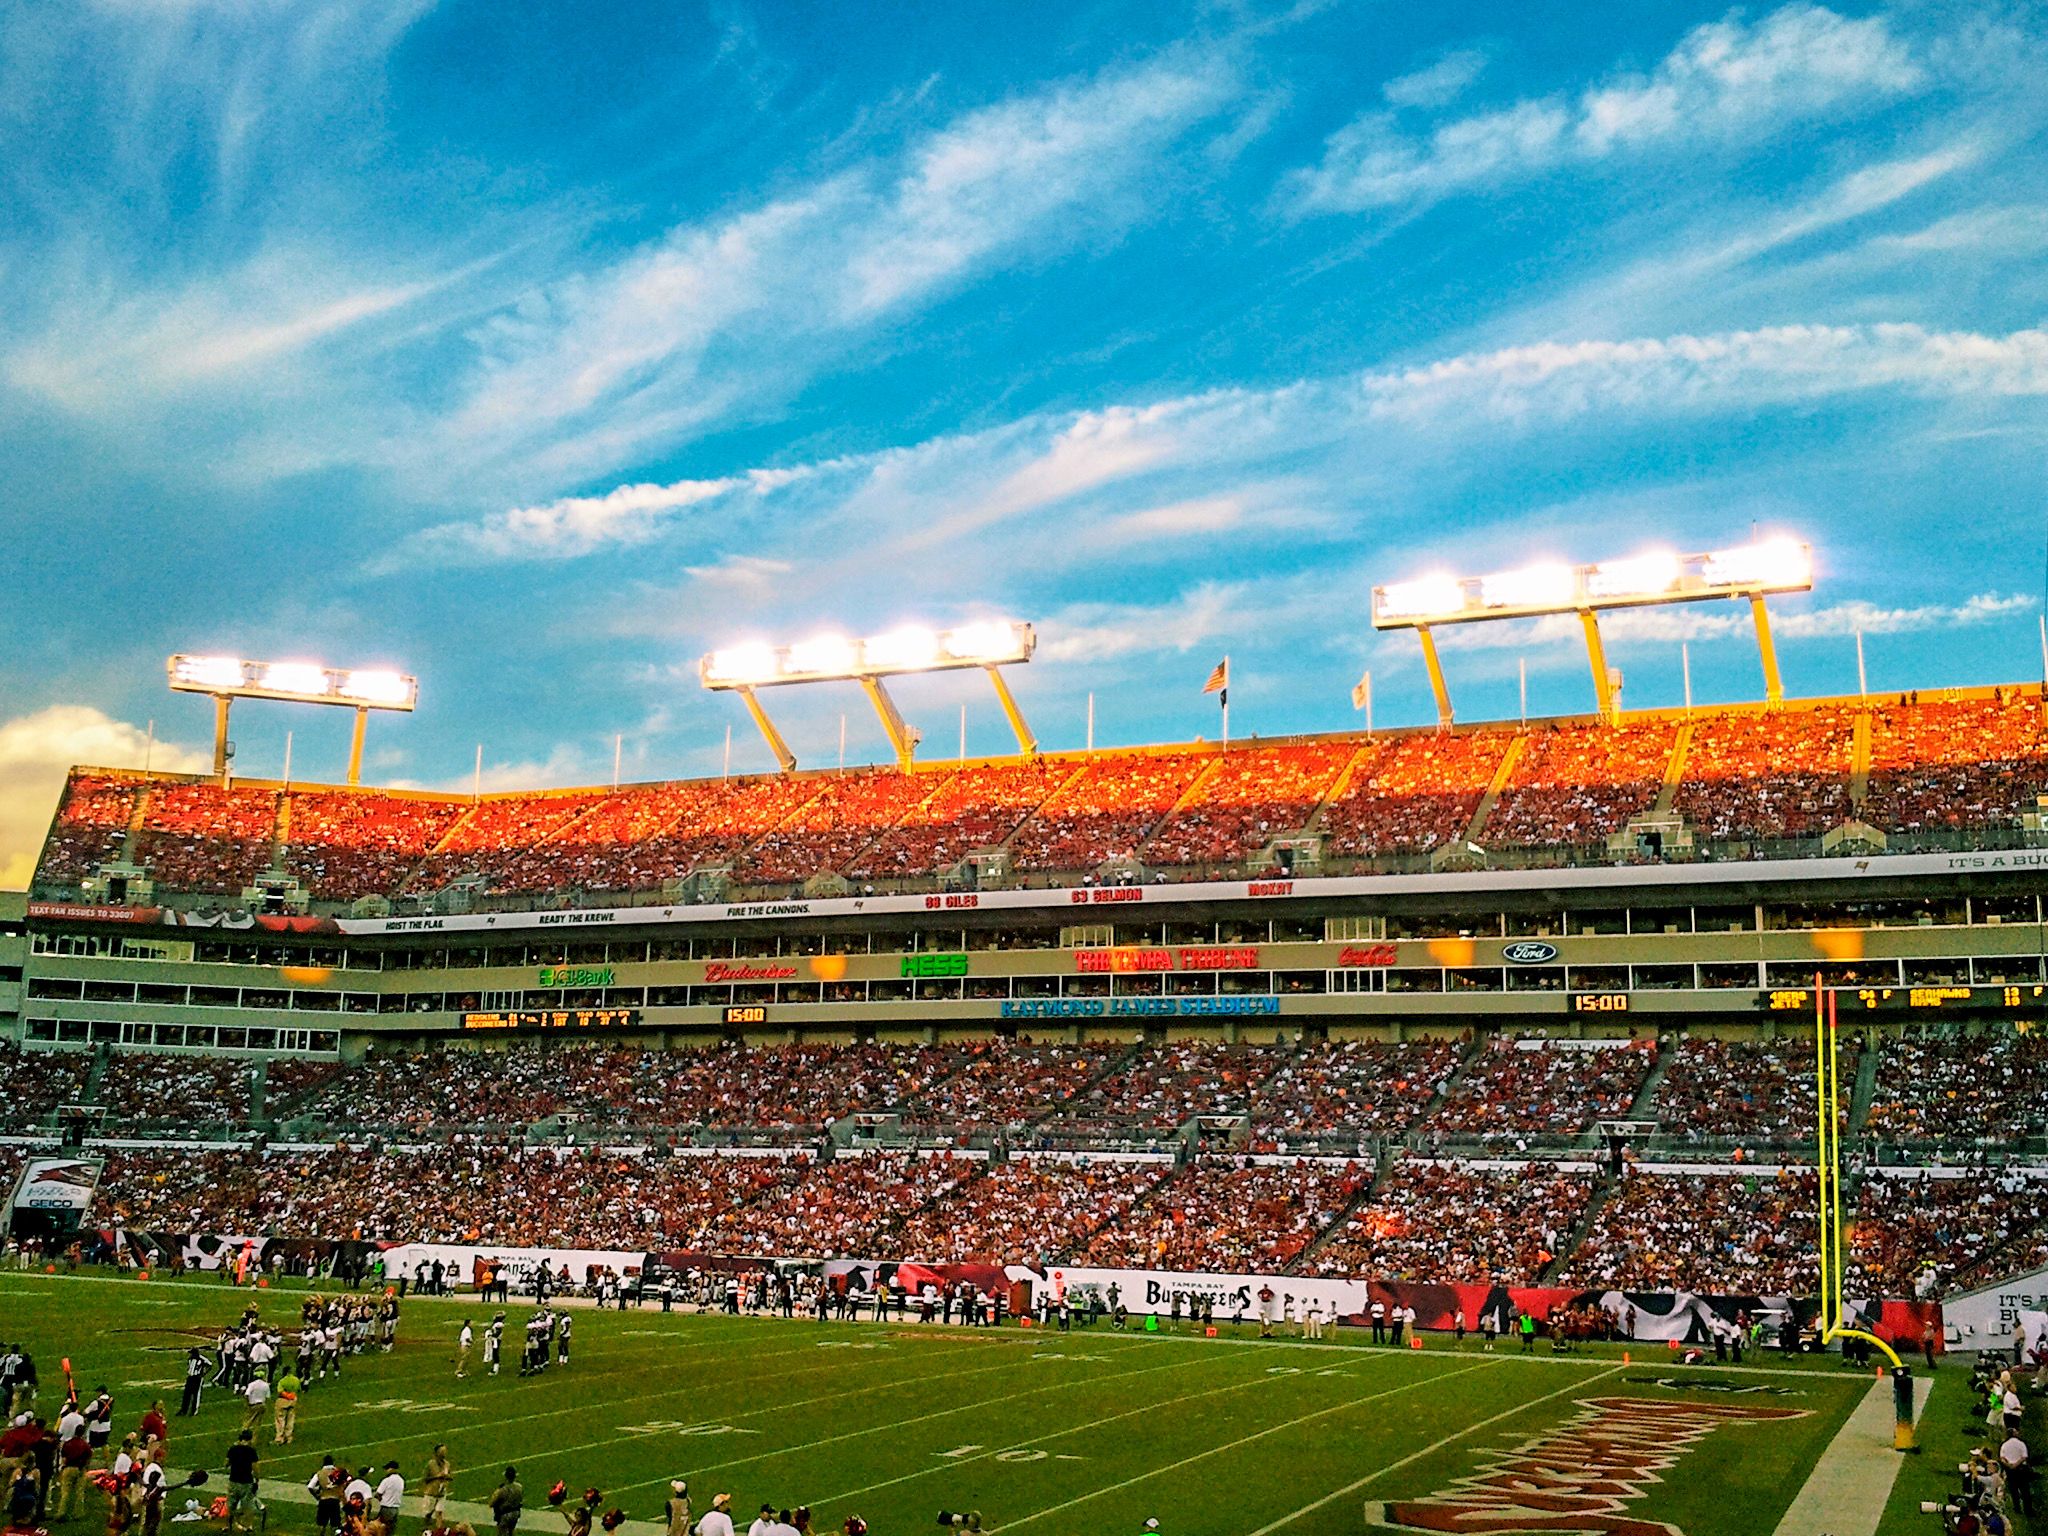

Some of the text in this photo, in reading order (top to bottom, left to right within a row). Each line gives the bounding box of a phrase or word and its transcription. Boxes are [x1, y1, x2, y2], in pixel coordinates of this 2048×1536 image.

[1948, 857, 1985, 868] IT'S
[1992, 857, 2005, 866] A
[1093, 888, 1143, 902] SELMON
[30, 905, 49, 914] TEXT
[50, 906, 65, 915] FAN
[67, 908, 96, 917] ISSUES
[97, 909, 108, 918] TO
[727, 904, 811, 916] FIRE THE CANNONS.
[539, 912, 616, 924] READY THE KREWE.
[385, 921, 407, 930] HOIST
[408, 920, 422, 929] THE
[1512, 944, 1546, 959] Ford
[901, 955, 968, 977] HESS
[1074, 950, 1110, 971] THE
[1179, 948, 1259, 970] TRIBUNE
[705, 963, 798, 982] Budweiser
[1882, 989, 1892, 1000] F
[2033, 986, 2043, 997] F
[1000, 996, 1281, 1018] RAYMOND JAMES STADIUM
[1576, 995, 1627, 1011] 15:00
[1770, 999, 1801, 1010] JETS
[727, 1008, 764, 1022] 15:00
[29, 1199, 73, 1208] GEICO
[1999, 1294, 2033, 1307] IT'S
